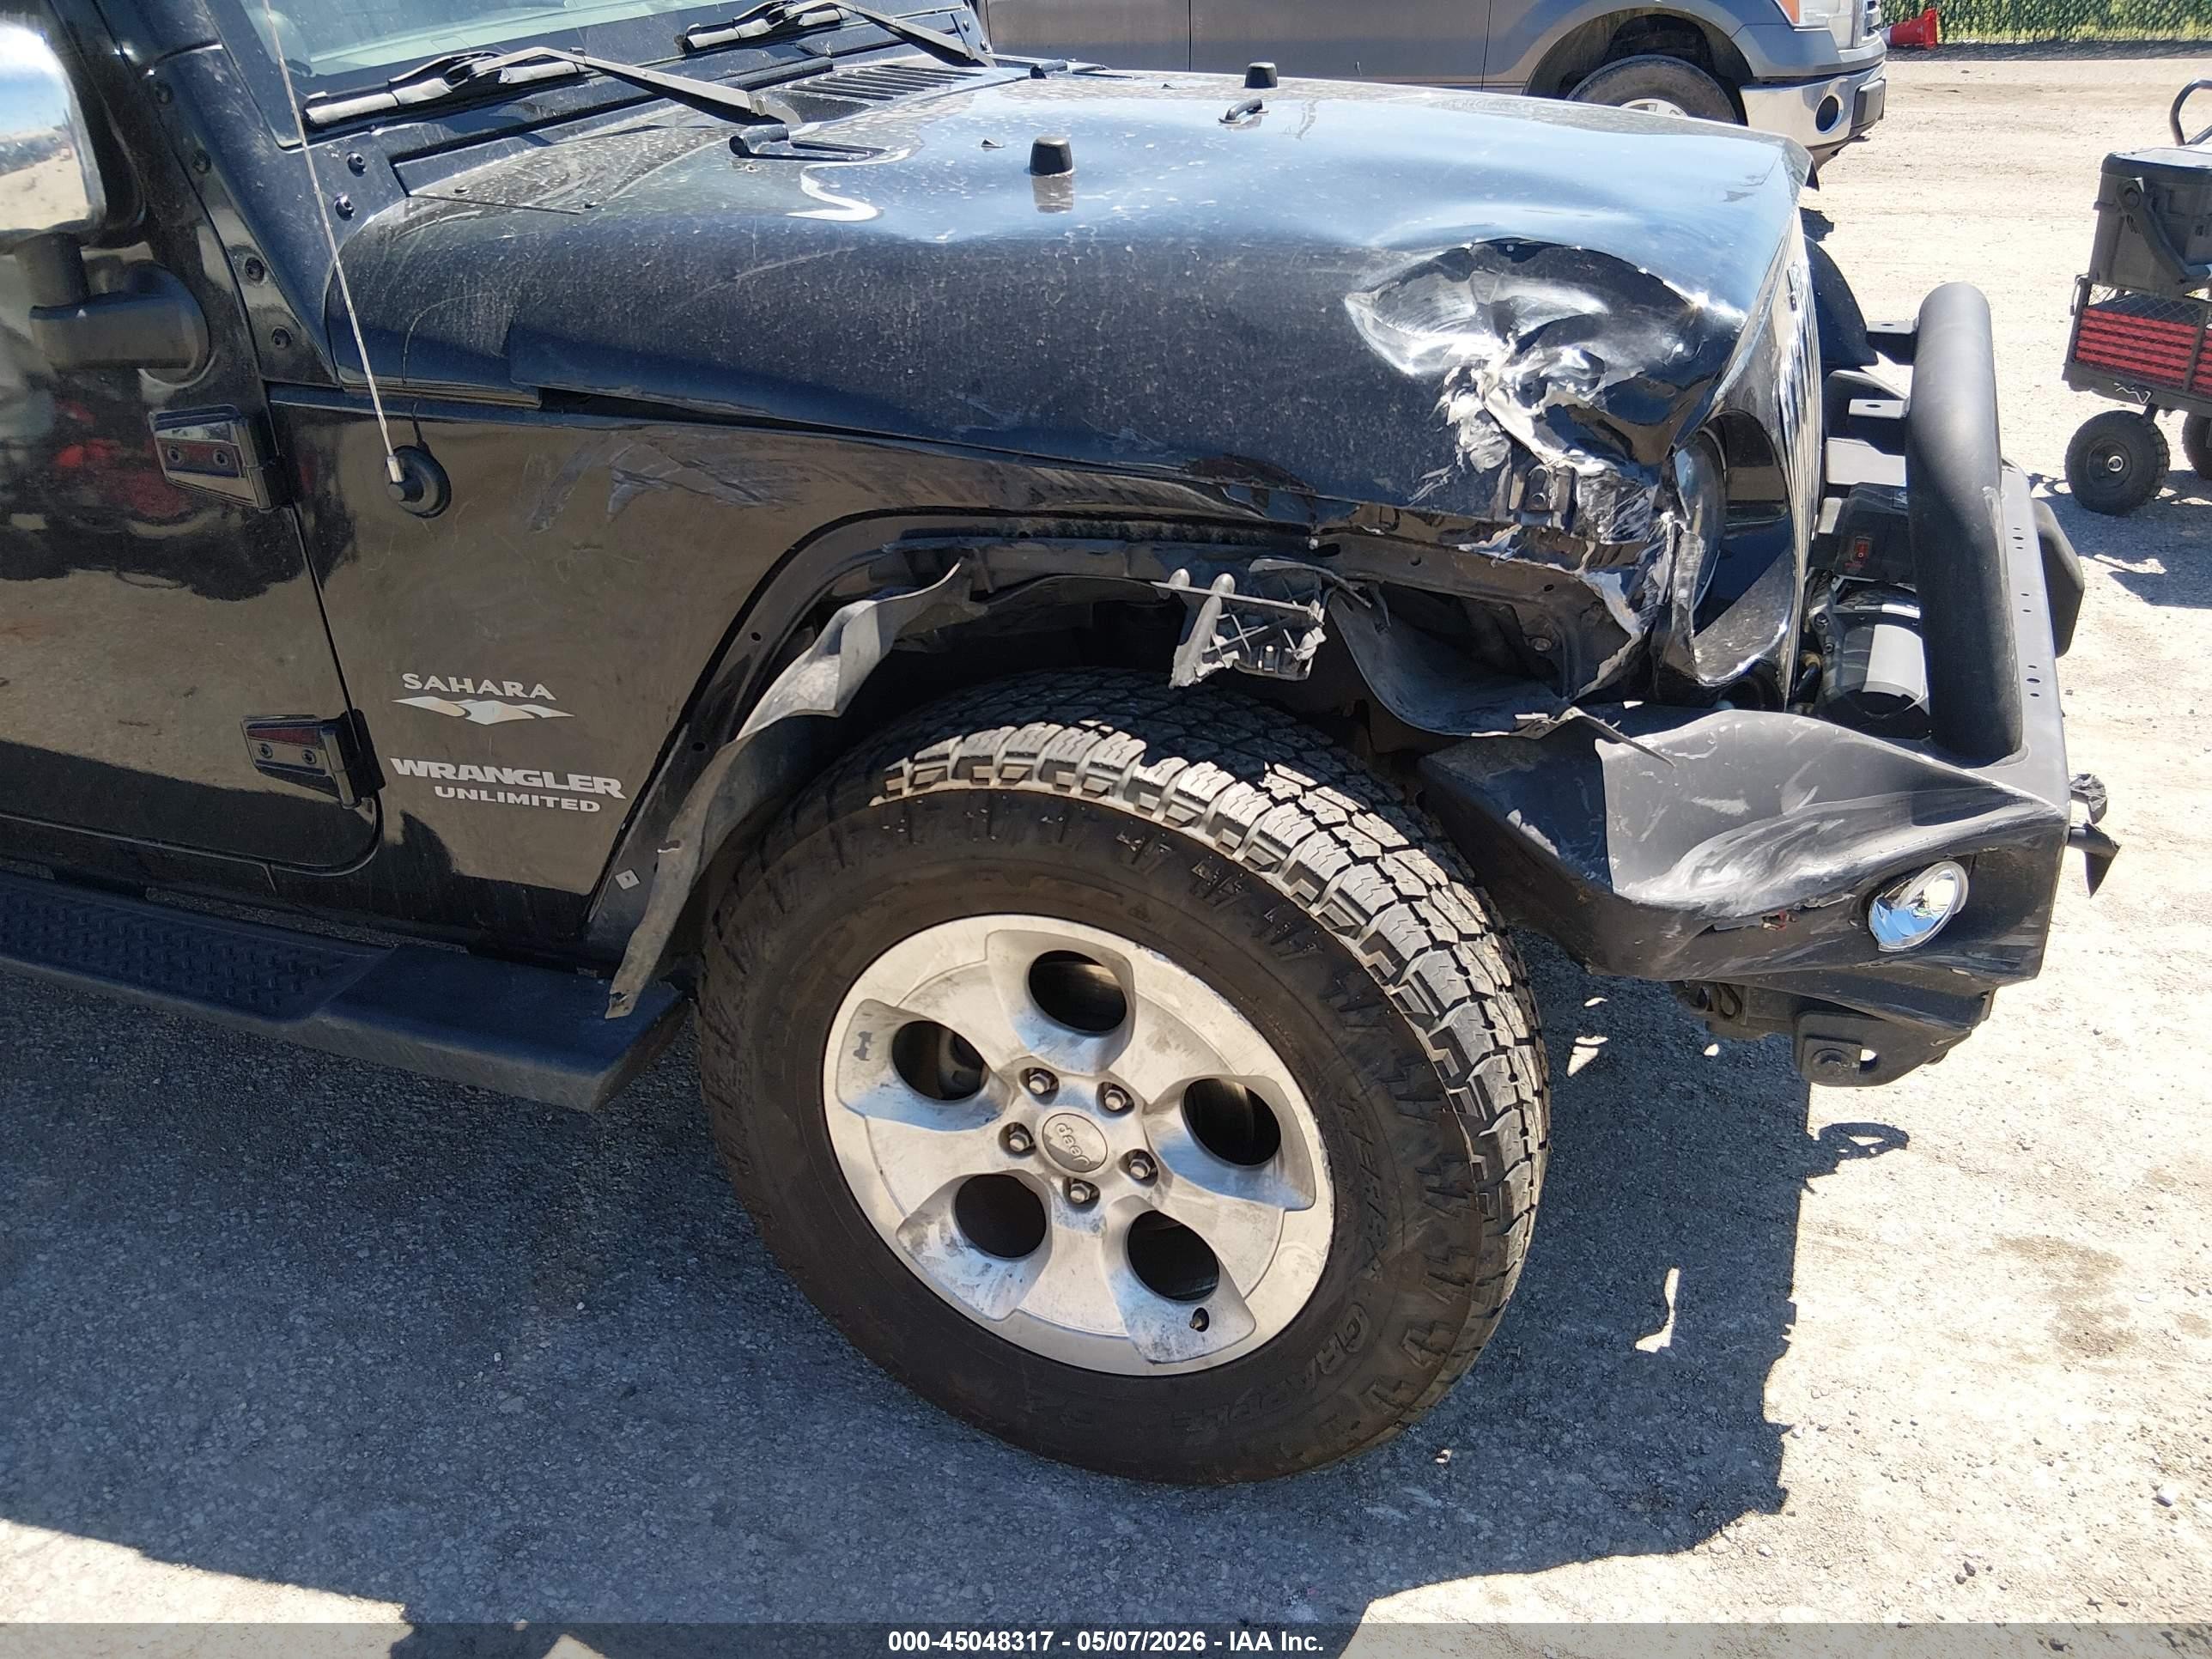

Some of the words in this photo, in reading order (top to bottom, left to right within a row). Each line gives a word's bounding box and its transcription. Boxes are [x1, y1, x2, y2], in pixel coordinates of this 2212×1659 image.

[401, 672, 557, 701] SAHARA
[390, 757, 626, 799] WRANGLER
[434, 785, 601, 812] UNLIMITED
[1055, 1122, 1091, 1166] Jeep
